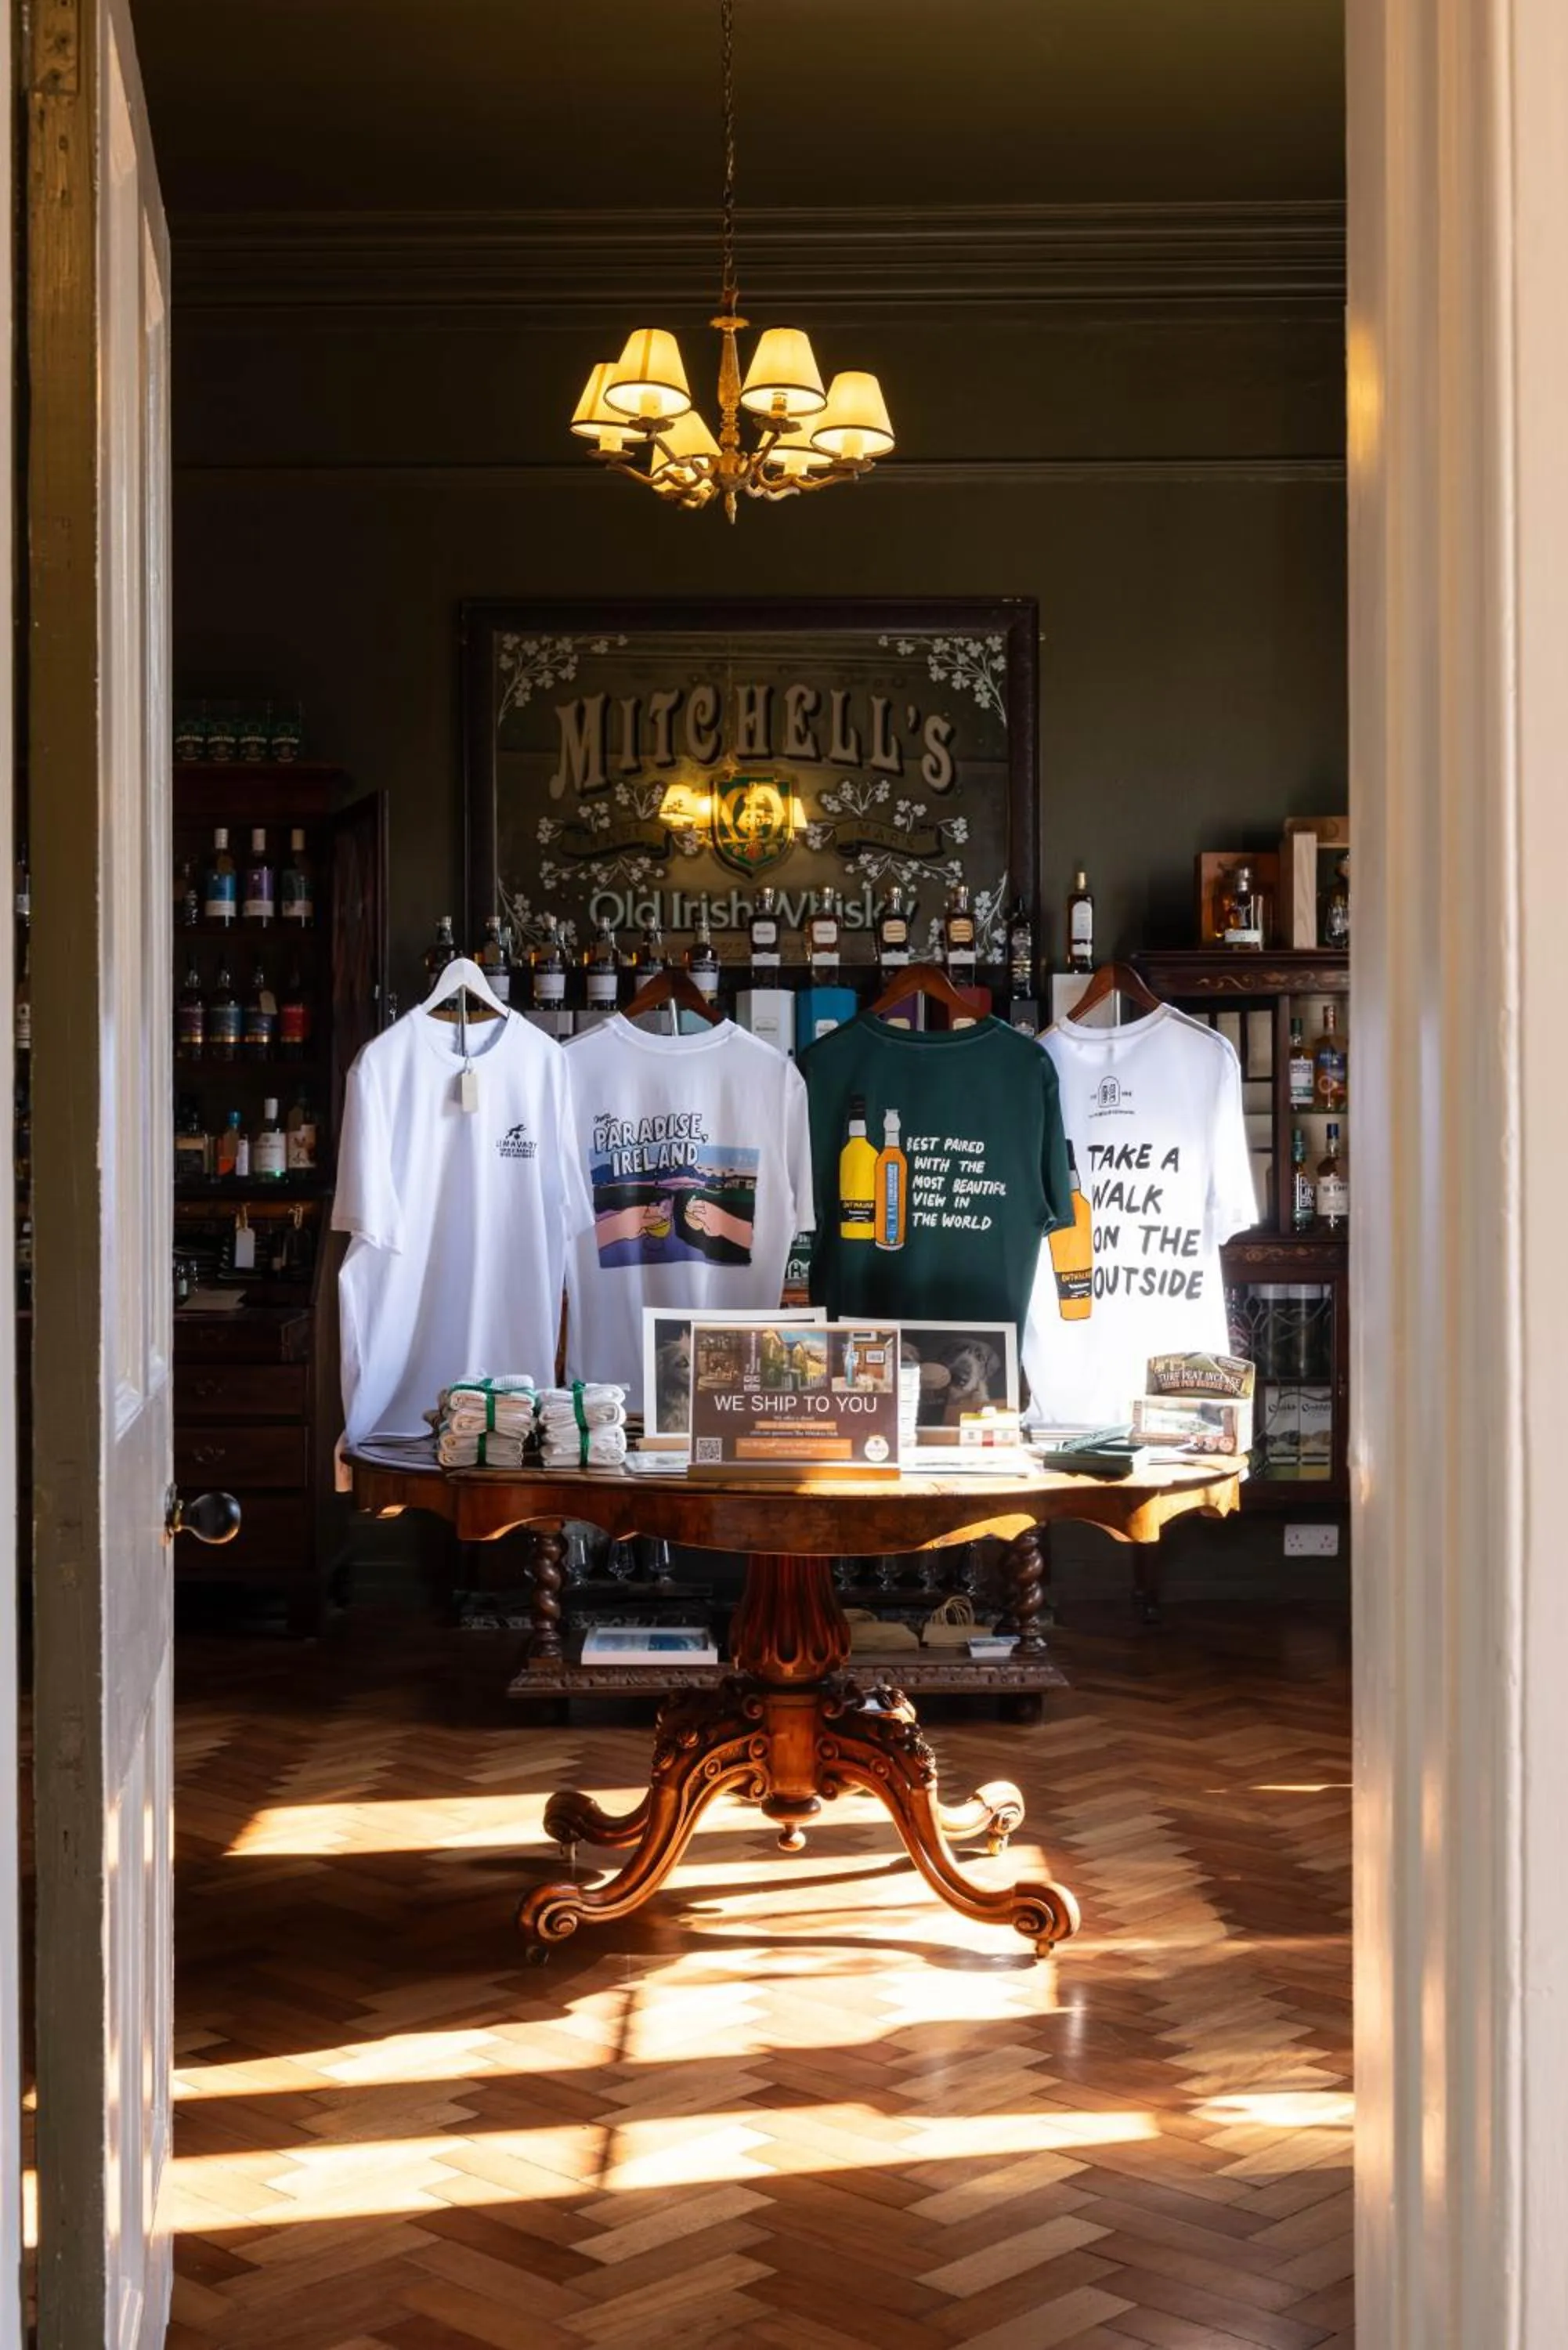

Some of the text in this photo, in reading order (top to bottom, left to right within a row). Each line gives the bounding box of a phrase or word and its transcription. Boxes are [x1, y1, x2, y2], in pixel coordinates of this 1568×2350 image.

[550, 684, 954, 799] MITCHELL'S
[590, 890, 660, 930] Old
[672, 890, 754, 930] Irish
[594, 1113, 709, 1153] PARADISE,
[906, 1137, 985, 1154] BEST PAIRED
[612, 1142, 699, 1177] IRELAND
[914, 1155, 985, 1173] WITH THE
[1087, 1143, 1180, 1173] TAKE A
[912, 1174, 945, 1191] MOST
[1092, 1179, 1163, 1215] WALK
[912, 1191, 970, 1208] VIEW IN
[912, 1212, 992, 1230] THE WORLD
[1093, 1224, 1201, 1256] ON THE
[1093, 1265, 1204, 1300] OUTSIDE
[714, 1395, 877, 1413] WE SHIP TO YOU
